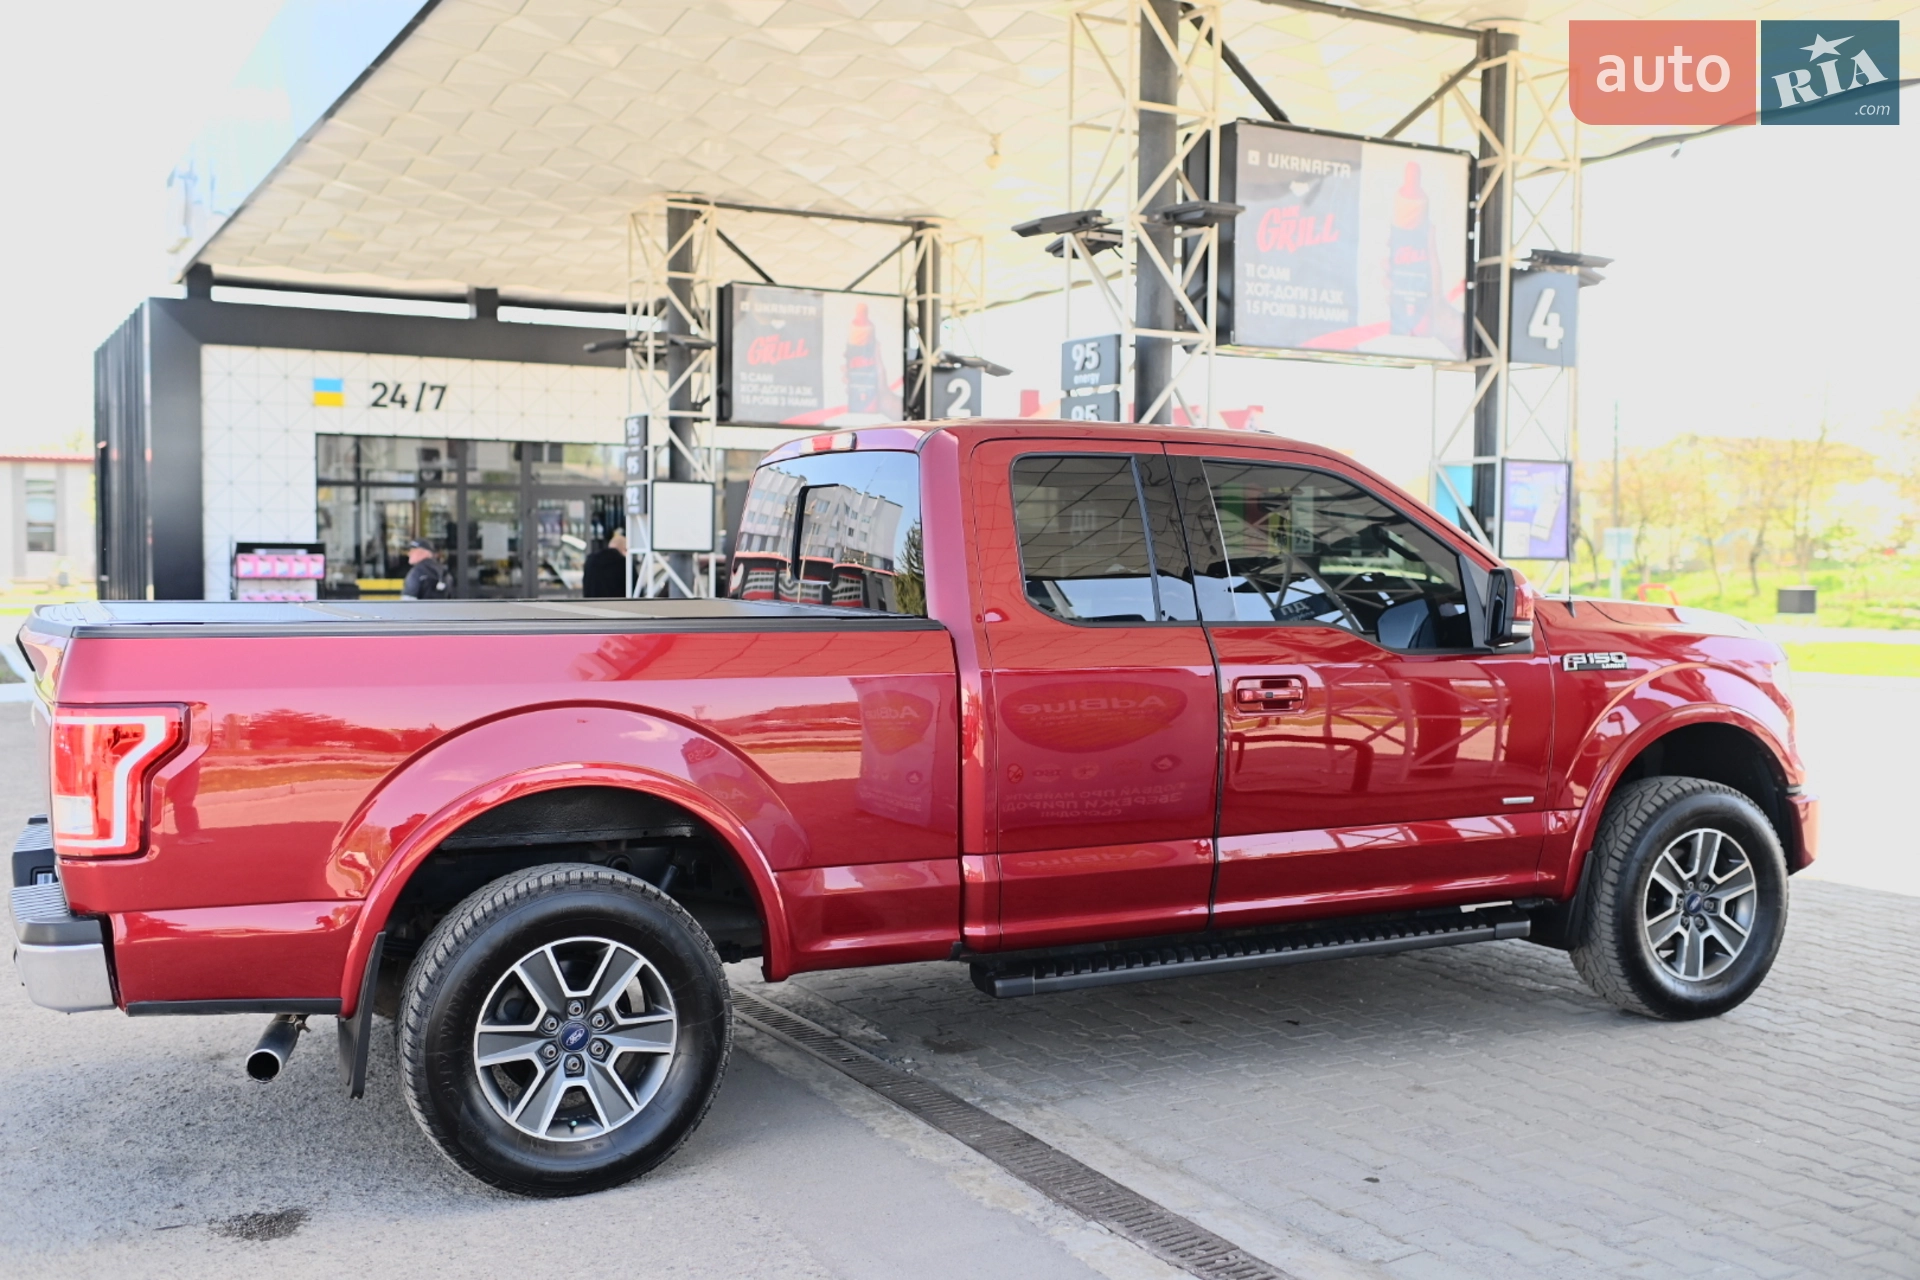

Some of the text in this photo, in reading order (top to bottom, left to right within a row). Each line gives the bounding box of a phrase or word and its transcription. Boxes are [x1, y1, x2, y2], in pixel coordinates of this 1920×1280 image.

[1267, 152, 1352, 178] UKRNAFTA
[1528, 288, 1565, 350] 4
[1071, 342, 1101, 371] 95
[371, 381, 447, 412] 24/7
[946, 378, 972, 417] 2
[626, 418, 640, 437] 95
[626, 456, 640, 475] 95
[625, 486, 640, 506] 92
